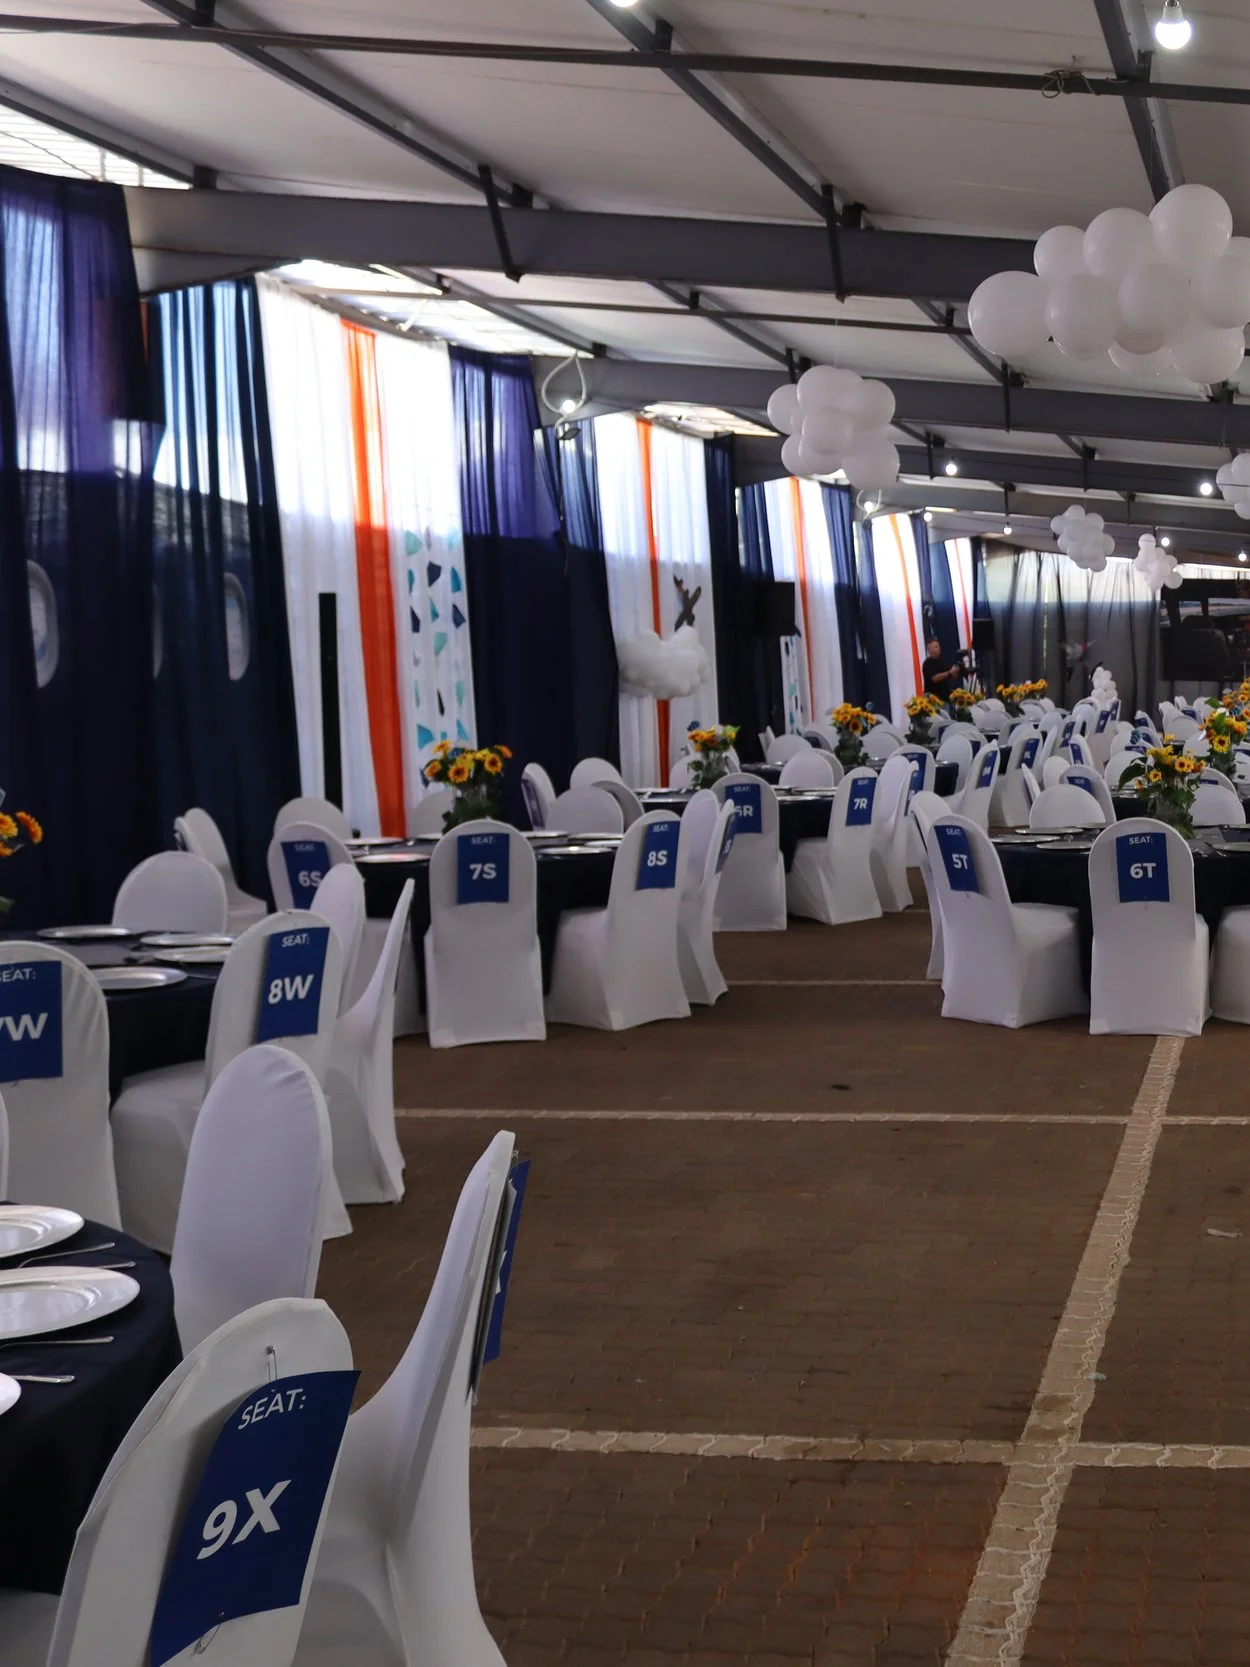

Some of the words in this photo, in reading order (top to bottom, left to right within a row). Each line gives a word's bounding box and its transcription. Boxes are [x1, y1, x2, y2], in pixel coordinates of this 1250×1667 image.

[853, 798, 868, 810] 7R
[1129, 836, 1154, 845] SEAT:
[647, 850, 668, 867] 8S
[952, 853, 968, 870] 5T
[297, 870, 321, 888] 6S
[469, 863, 497, 881] 7S
[1129, 862, 1156, 879] 6T
[281, 934, 310, 948] SEAT:
[267, 973, 315, 1005] 8W
[0, 1011, 49, 1042] W
[237, 1388, 306, 1430] SEAT:
[195, 1479, 292, 1560] 9X
